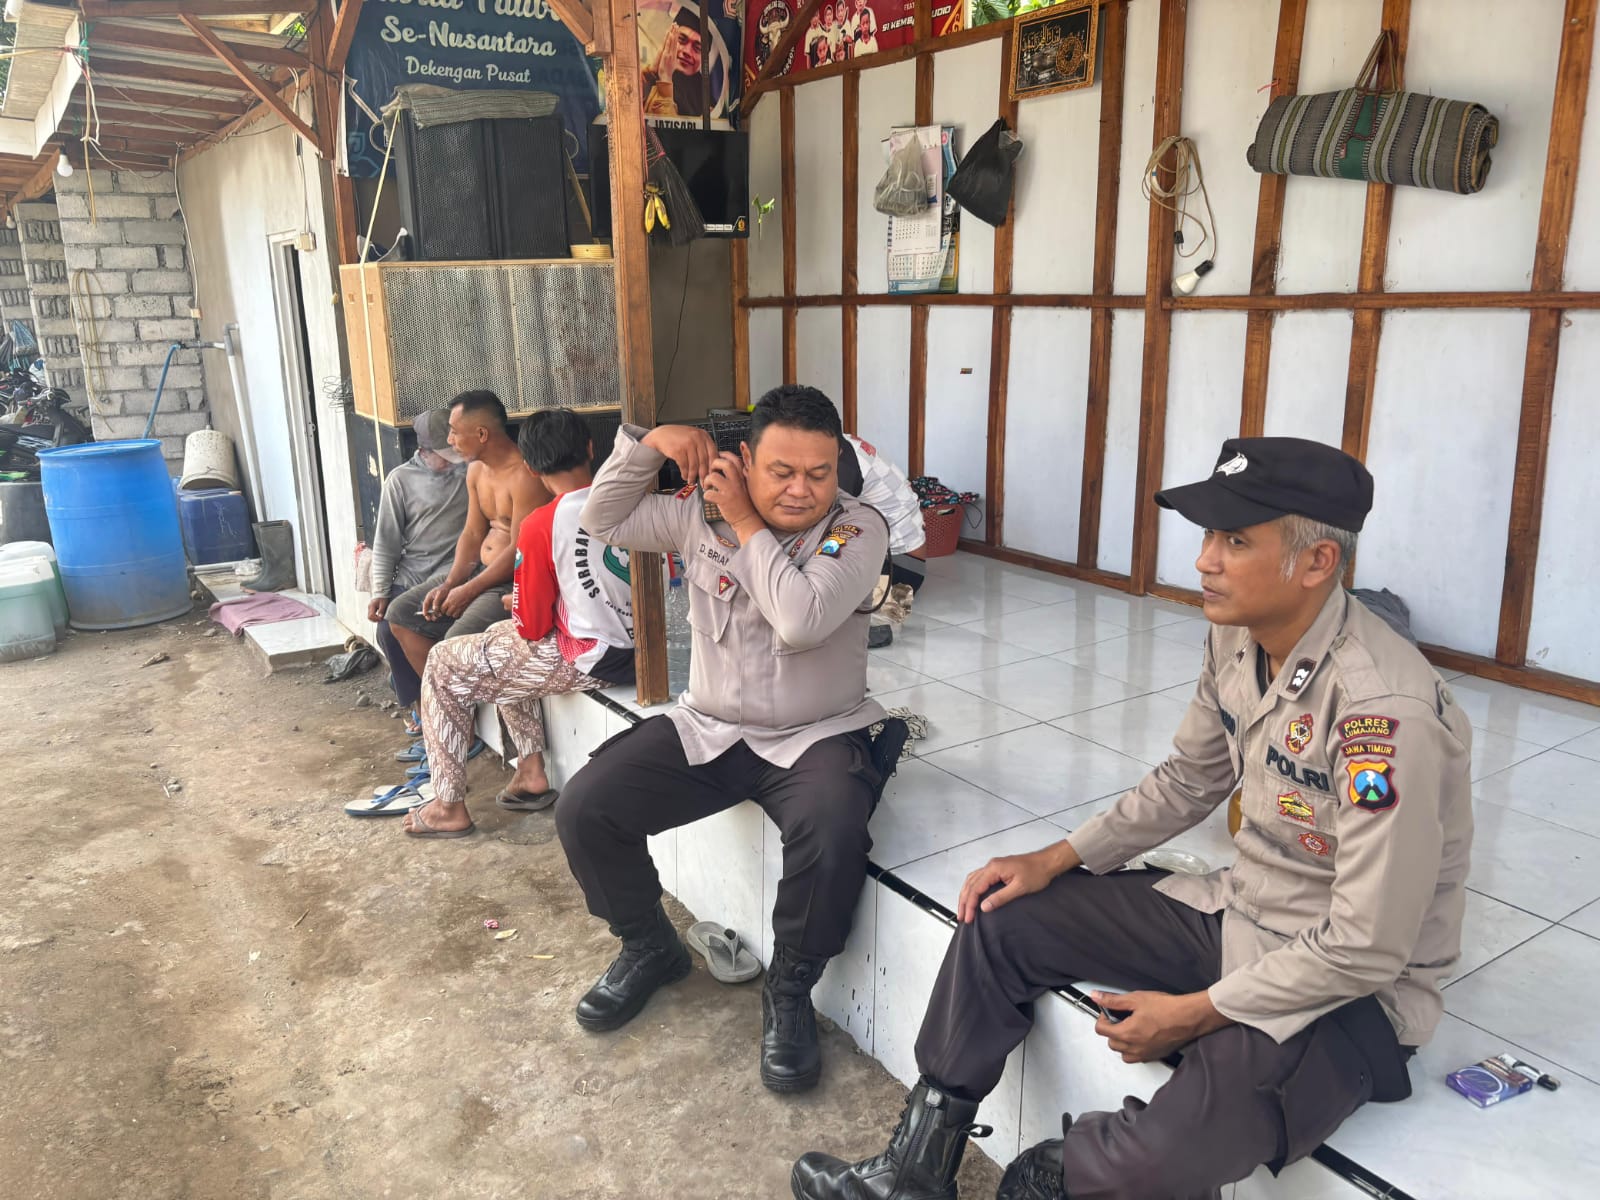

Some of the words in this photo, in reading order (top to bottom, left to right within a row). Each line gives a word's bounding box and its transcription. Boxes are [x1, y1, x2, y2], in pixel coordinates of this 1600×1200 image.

[931, 5, 952, 18] UDIO
[380, 15, 557, 57] Se-Nusantara
[404, 55, 483, 84] Dekengan
[485, 63, 532, 84] Pusat
[574, 527, 601, 599] SURABAY
[1344, 718, 1389, 732] POLRES
[1345, 744, 1365, 755] JAWA
[1366, 744, 1393, 755] TIMUR
[1265, 744, 1330, 792] POLRI
